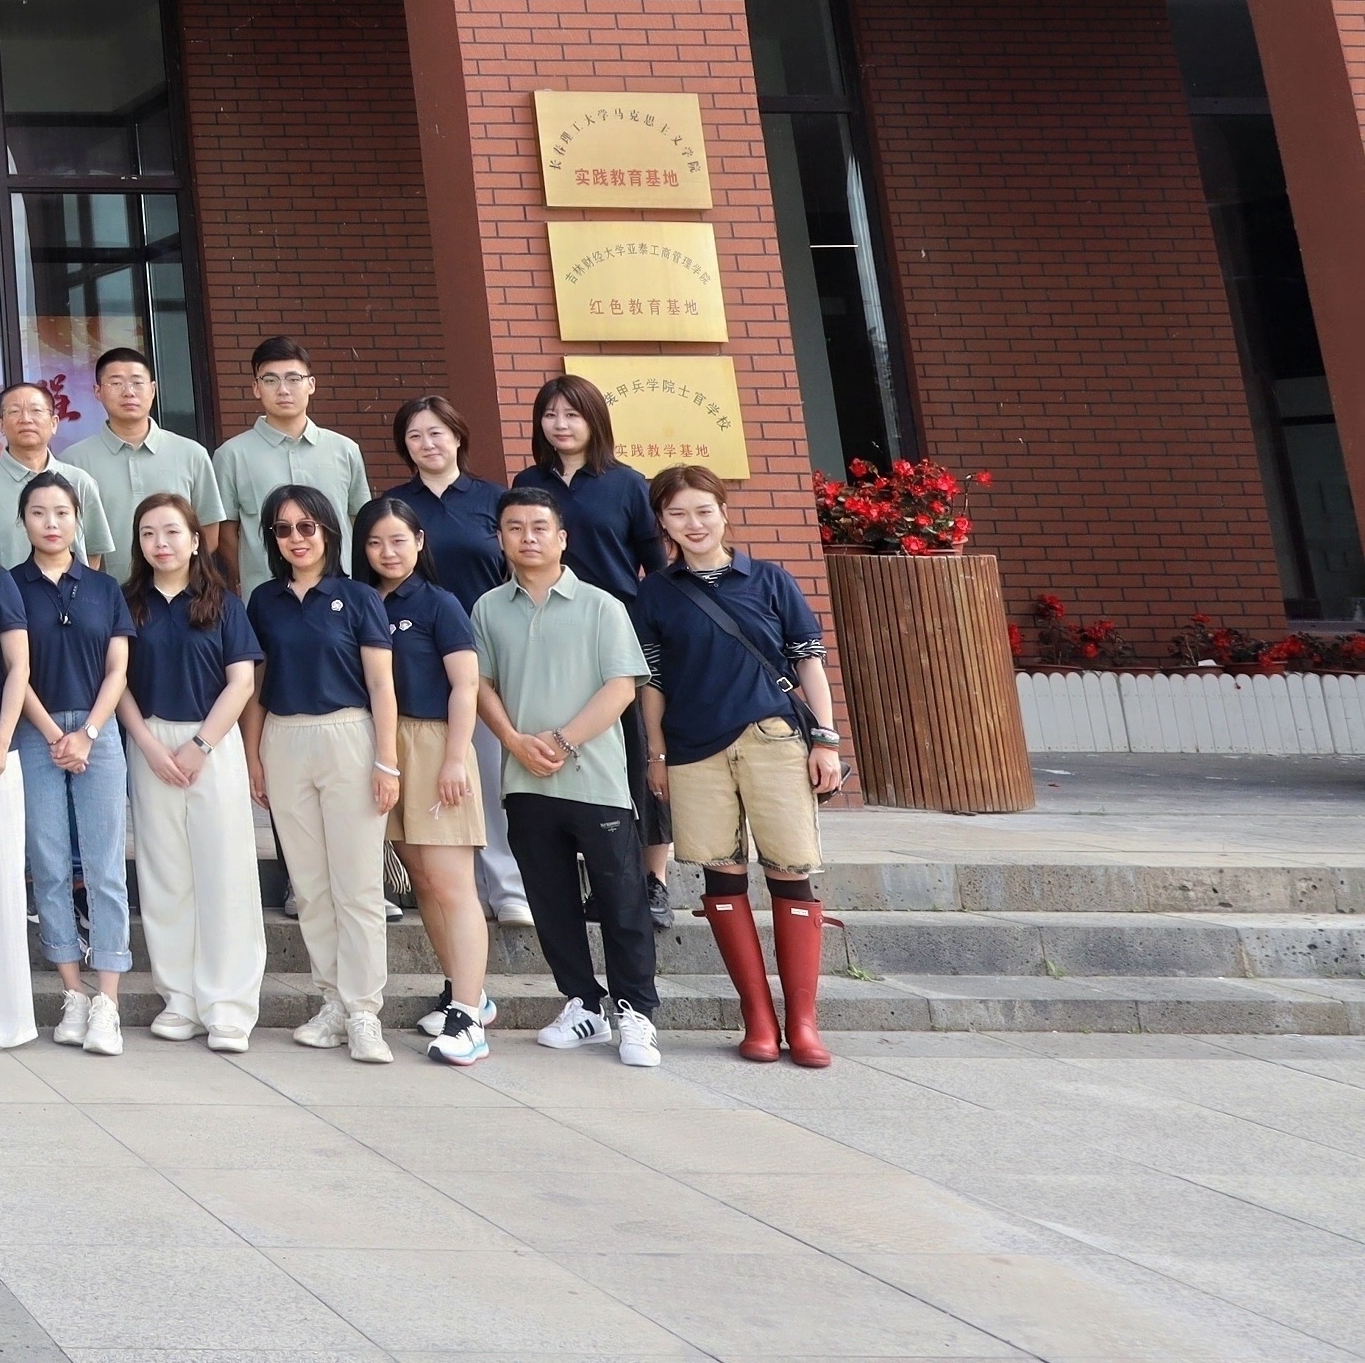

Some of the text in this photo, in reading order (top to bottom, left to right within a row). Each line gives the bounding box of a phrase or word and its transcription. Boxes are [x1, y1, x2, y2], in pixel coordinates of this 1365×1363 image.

[549, 107, 701, 173] 长春理工大学马克思主义学院
[574, 168, 680, 187] 实践教育基地
[565, 242, 711, 285] 吉林财经大学亚泰工商管理学院
[588, 298, 699, 316] 红色教育基地
[614, 443, 710, 459] 实践教学基地
